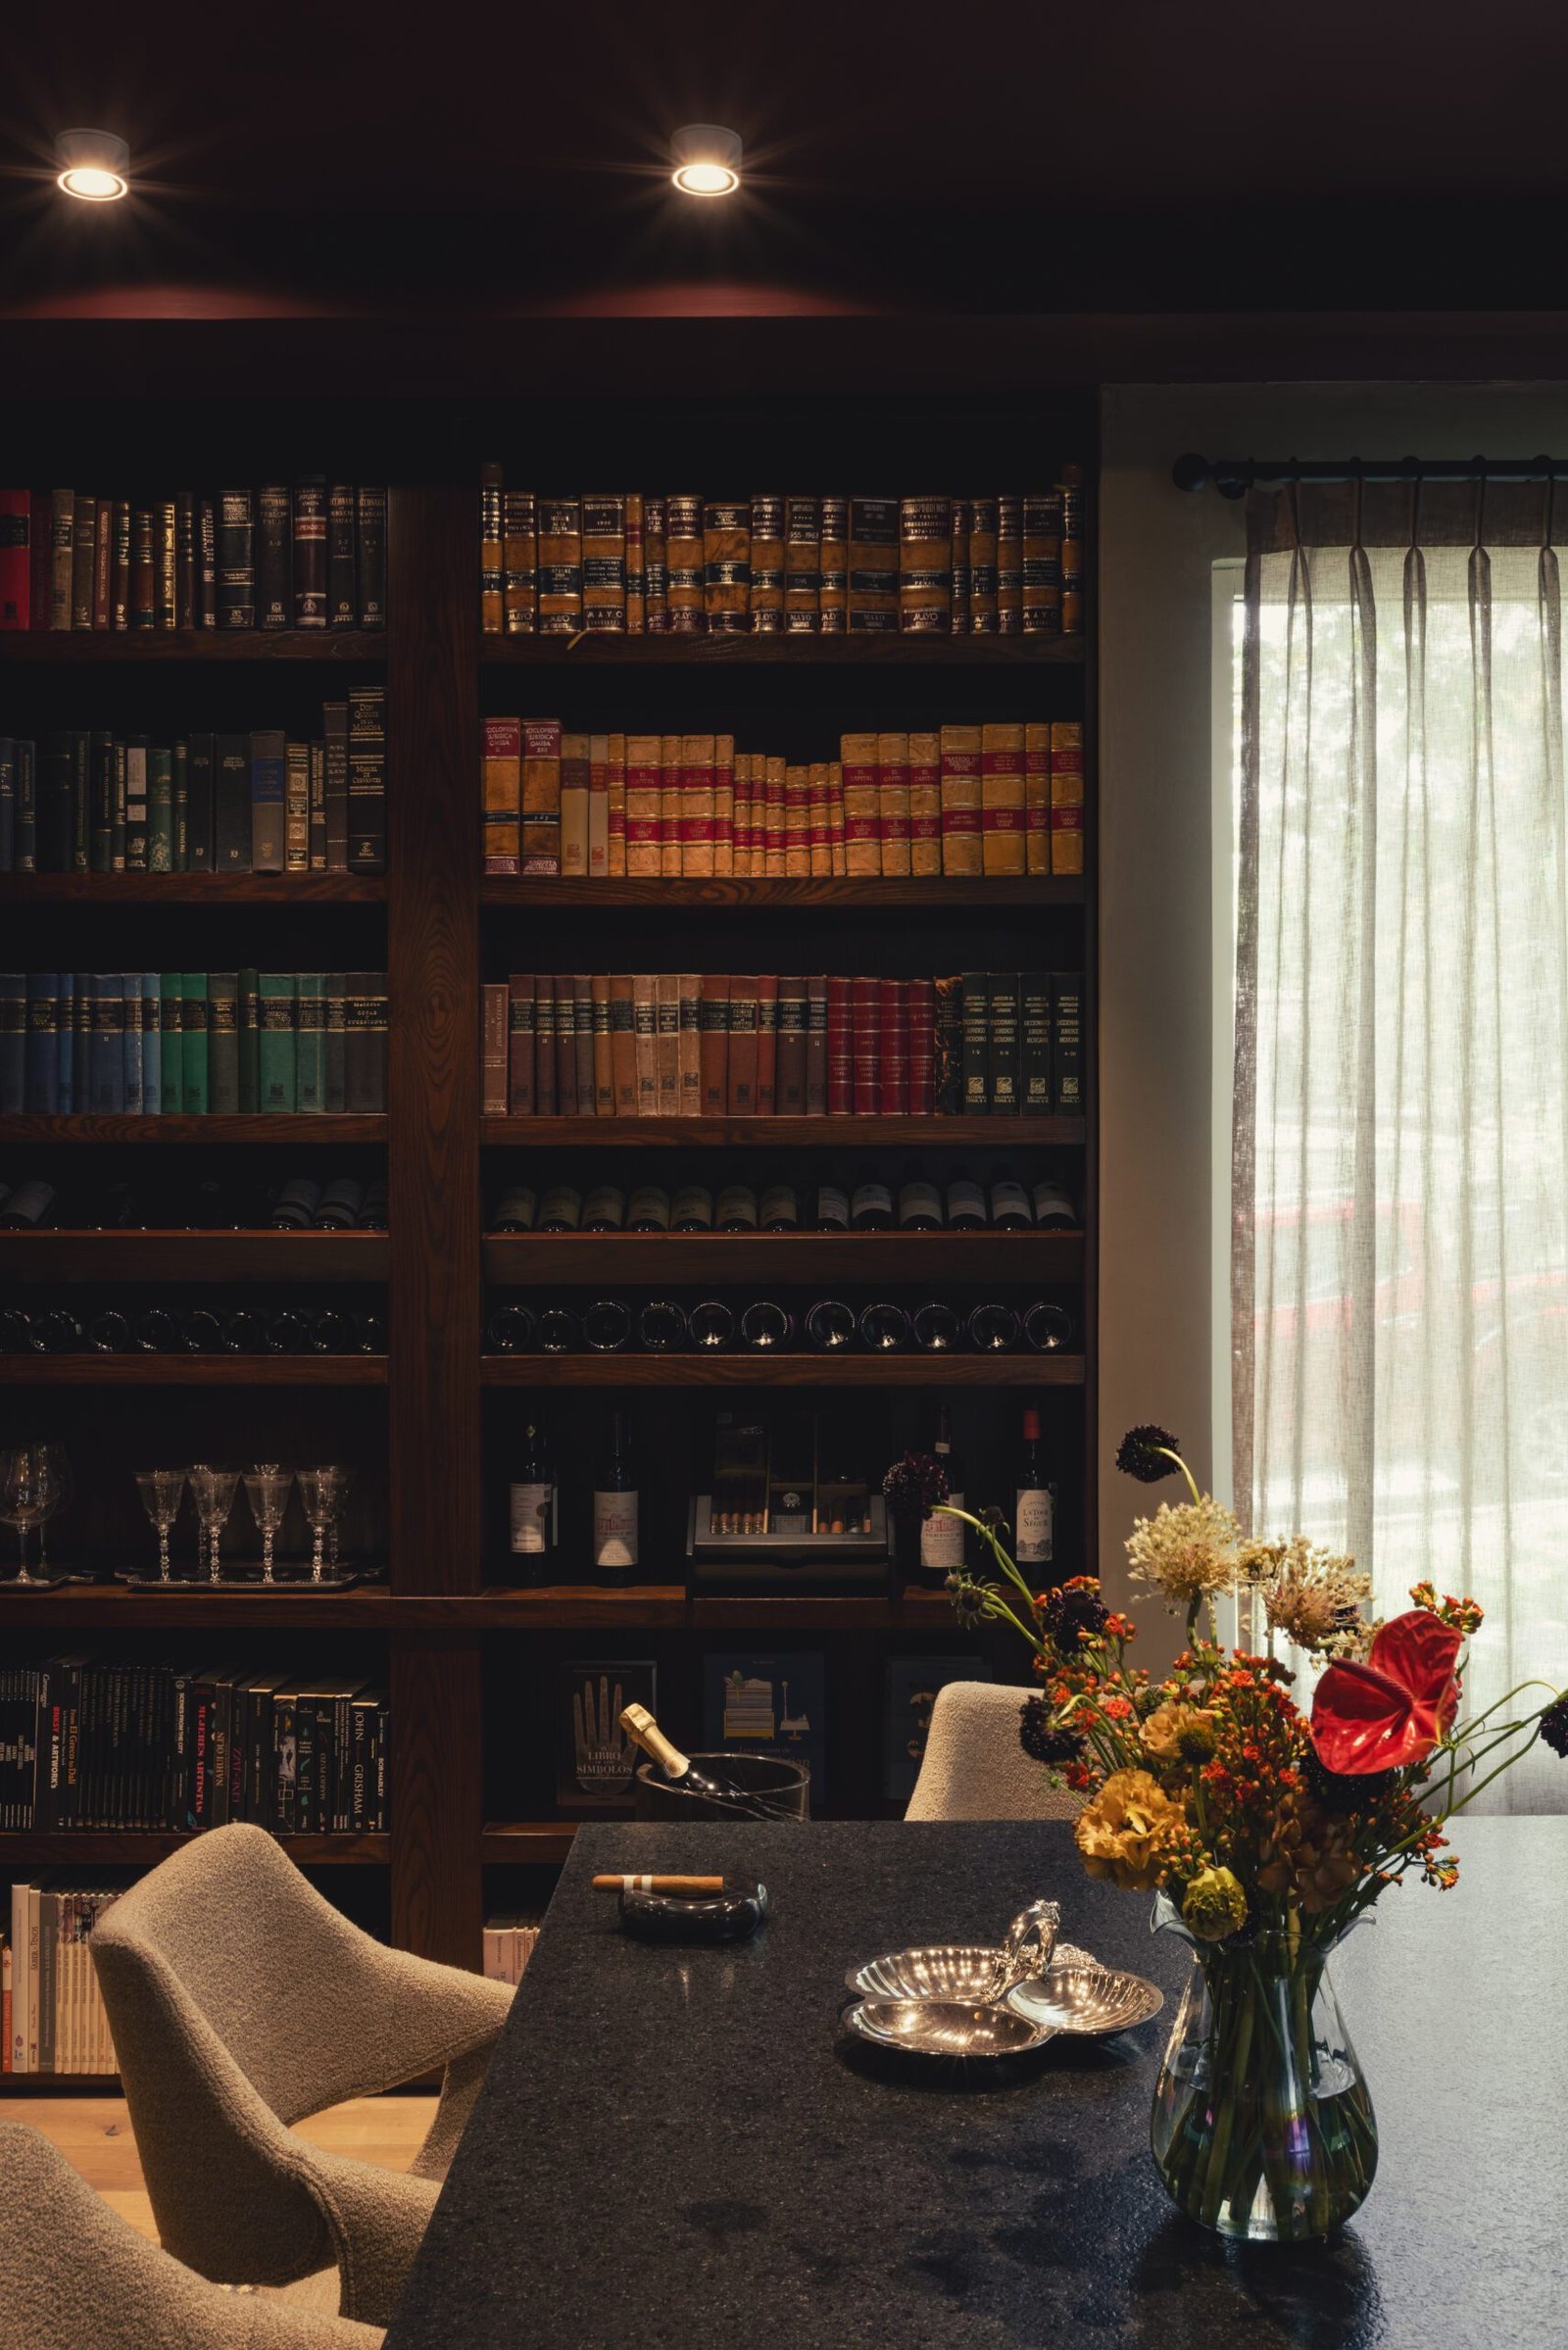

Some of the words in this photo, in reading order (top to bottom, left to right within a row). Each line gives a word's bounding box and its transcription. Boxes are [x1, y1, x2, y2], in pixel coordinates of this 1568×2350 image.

[508, 612, 533, 621] MAYO
[673, 612, 698, 620] MAYO
[912, 612, 939, 621] MAYO
[196, 1703, 207, 1757] MUJERES
[354, 1711, 365, 1740] JOHN
[69, 1735, 78, 1760] Greco
[587, 1751, 621, 1761] LIBRO
[216, 1757, 224, 1787] NAHUI
[576, 1762, 633, 1775] SÍMBOLOS
[195, 1759, 205, 1814] ARTISTAS
[353, 1763, 365, 1814] GRISHAM
